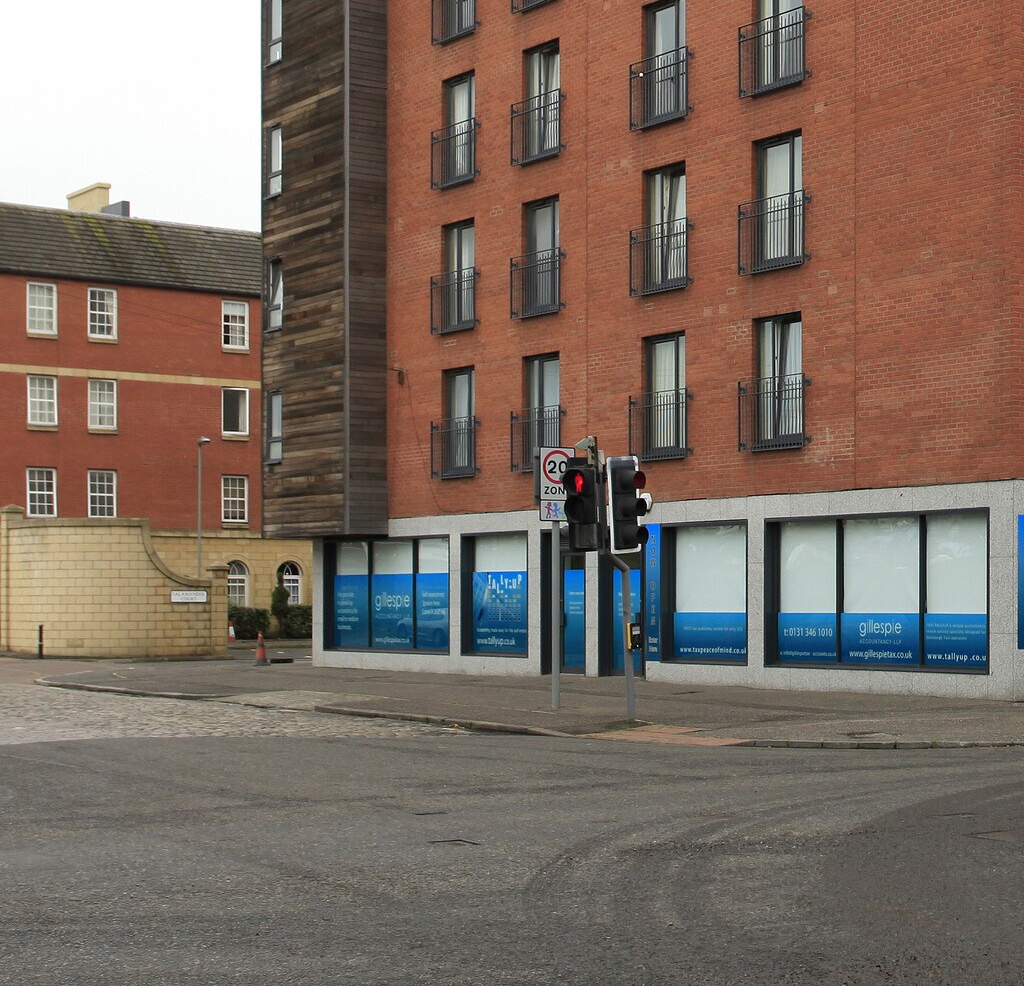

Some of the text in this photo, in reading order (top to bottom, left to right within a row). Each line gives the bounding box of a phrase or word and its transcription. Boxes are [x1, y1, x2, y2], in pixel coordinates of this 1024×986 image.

[547, 460, 567, 474] 20
[544, 486, 566, 495] ZON
[375, 592, 410, 610] gillespie
[805, 628, 816, 637] 346
[818, 628, 833, 637] 1010
[859, 619, 902, 637] gillespie
[680, 647, 746, 655] www.taxpeaceofmind.co.uk
[849, 650, 912, 659] www.gillespietax.co.uk
